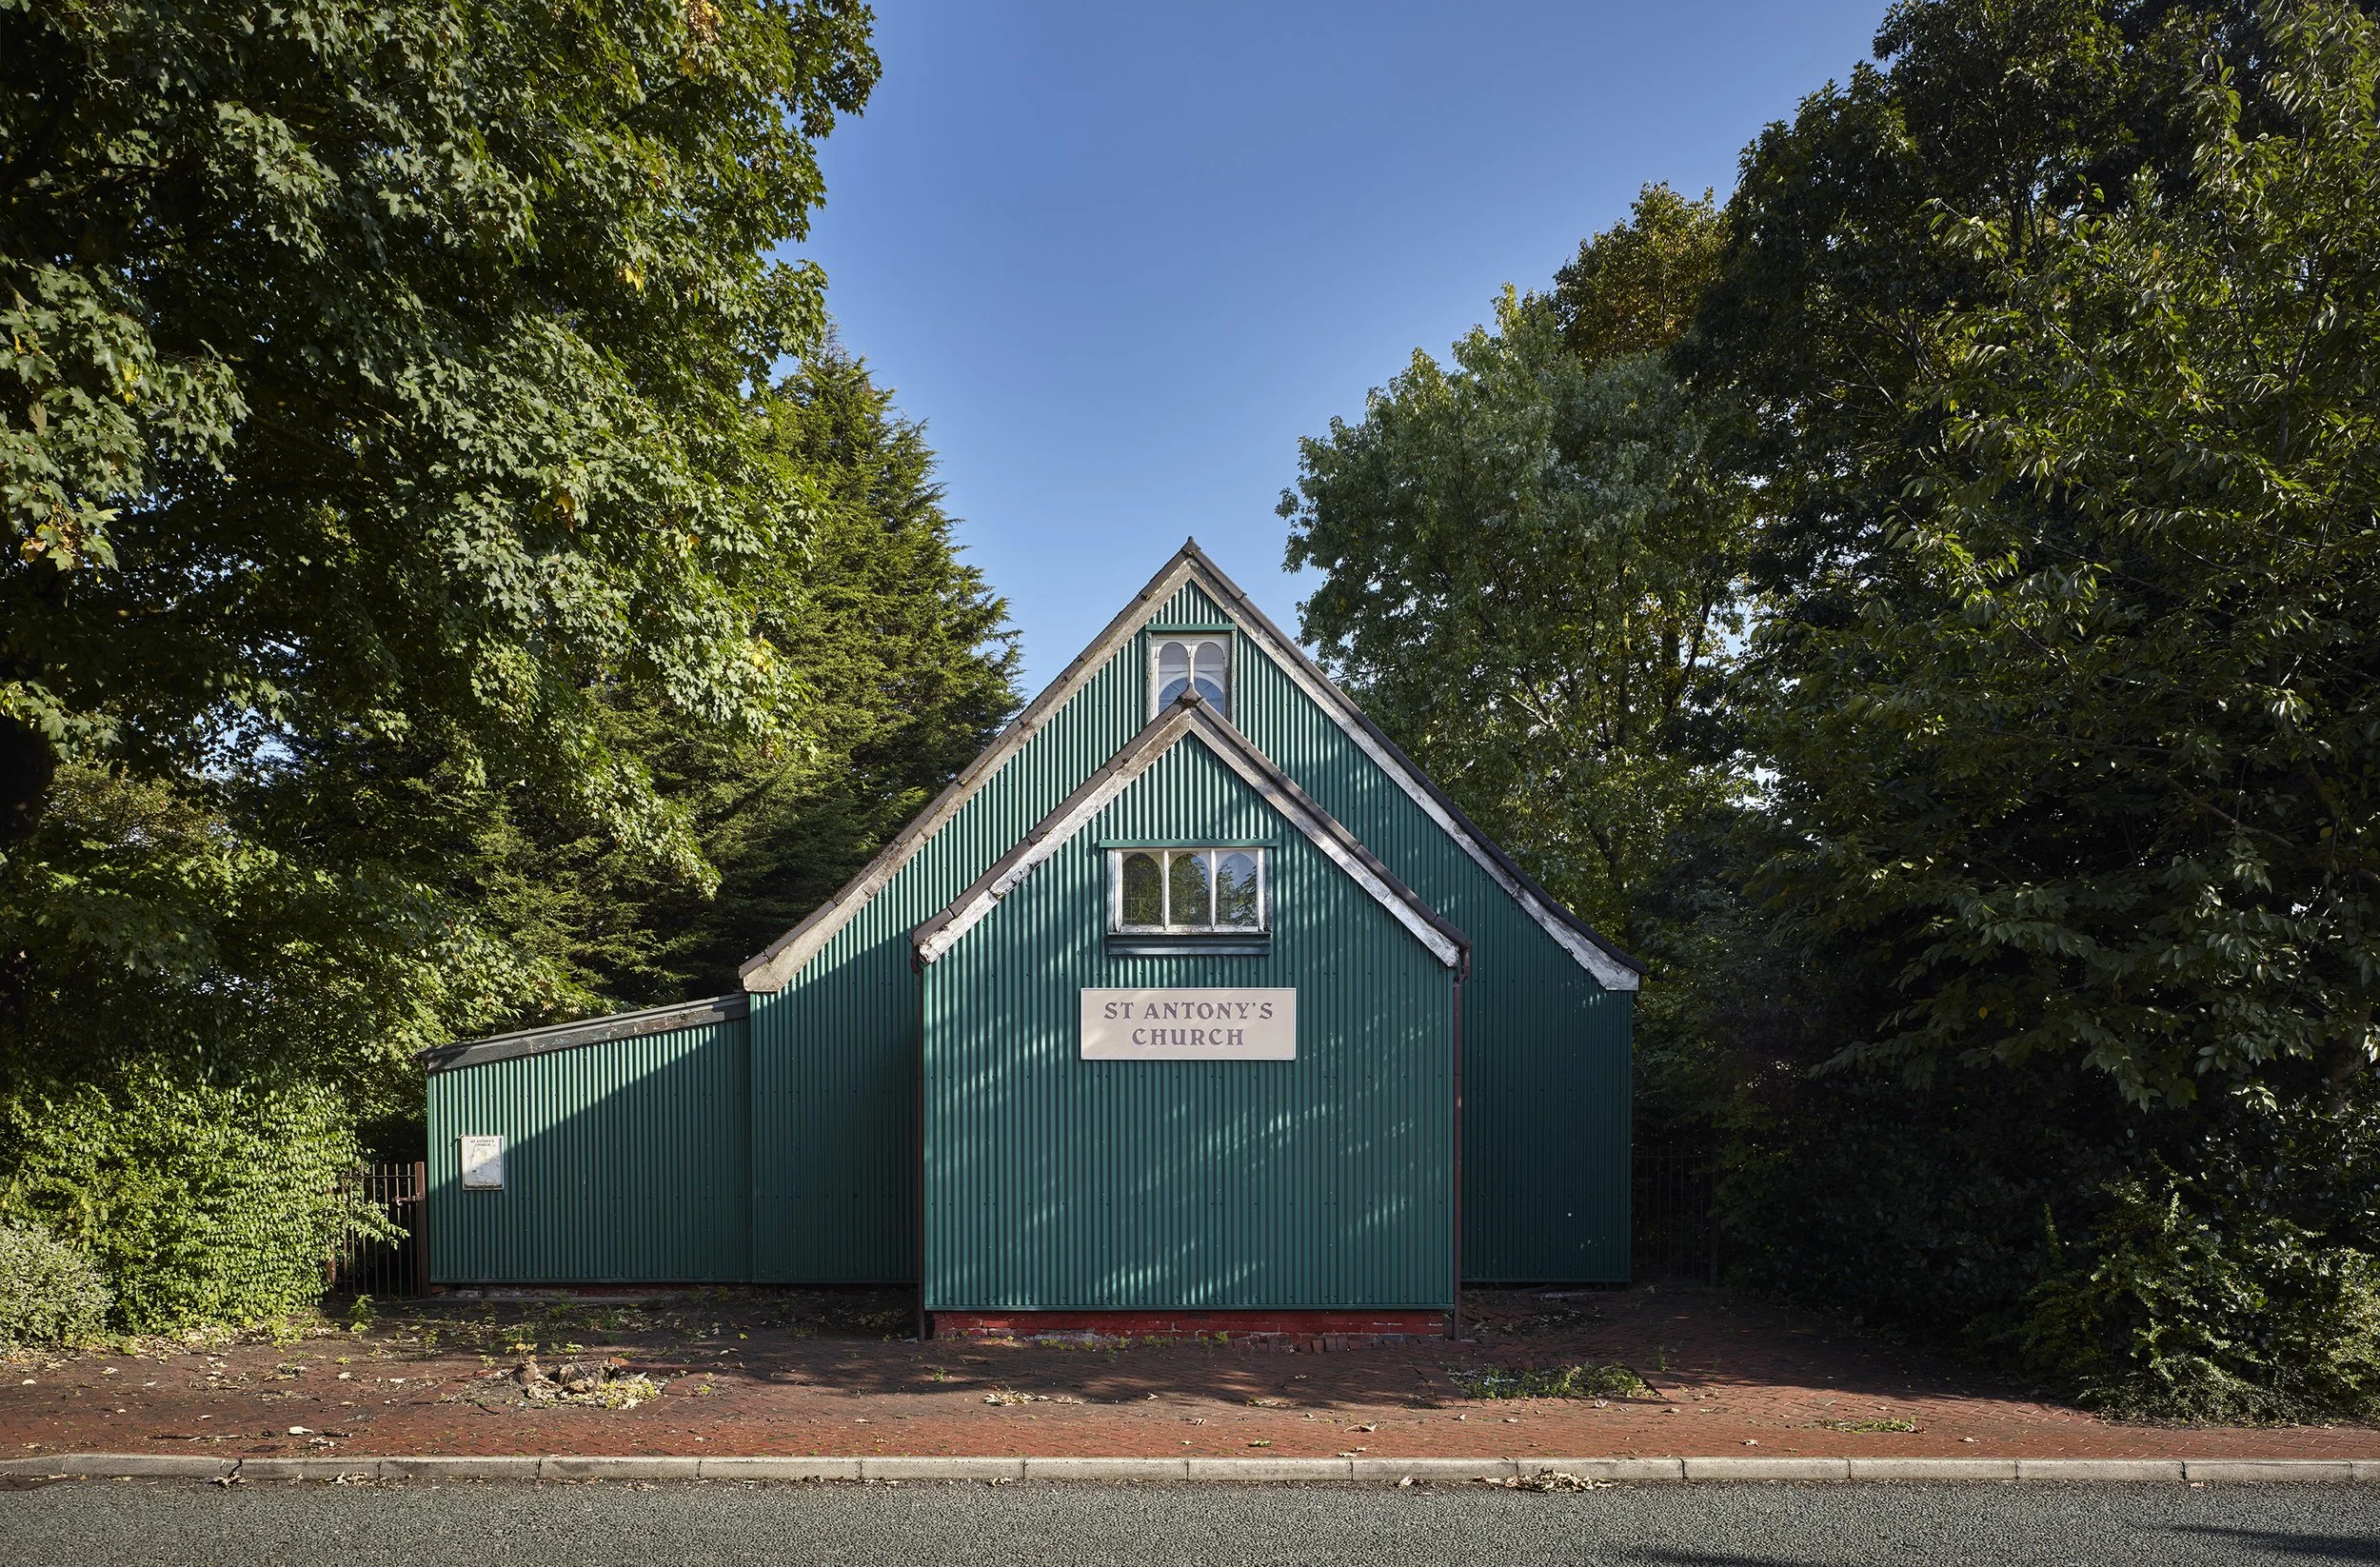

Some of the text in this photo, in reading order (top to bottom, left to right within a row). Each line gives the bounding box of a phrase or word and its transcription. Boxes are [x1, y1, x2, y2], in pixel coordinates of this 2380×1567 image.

[1103, 1002, 1274, 1020] ST ANTONY'S
[1132, 1028, 1244, 1045] CHURCH
